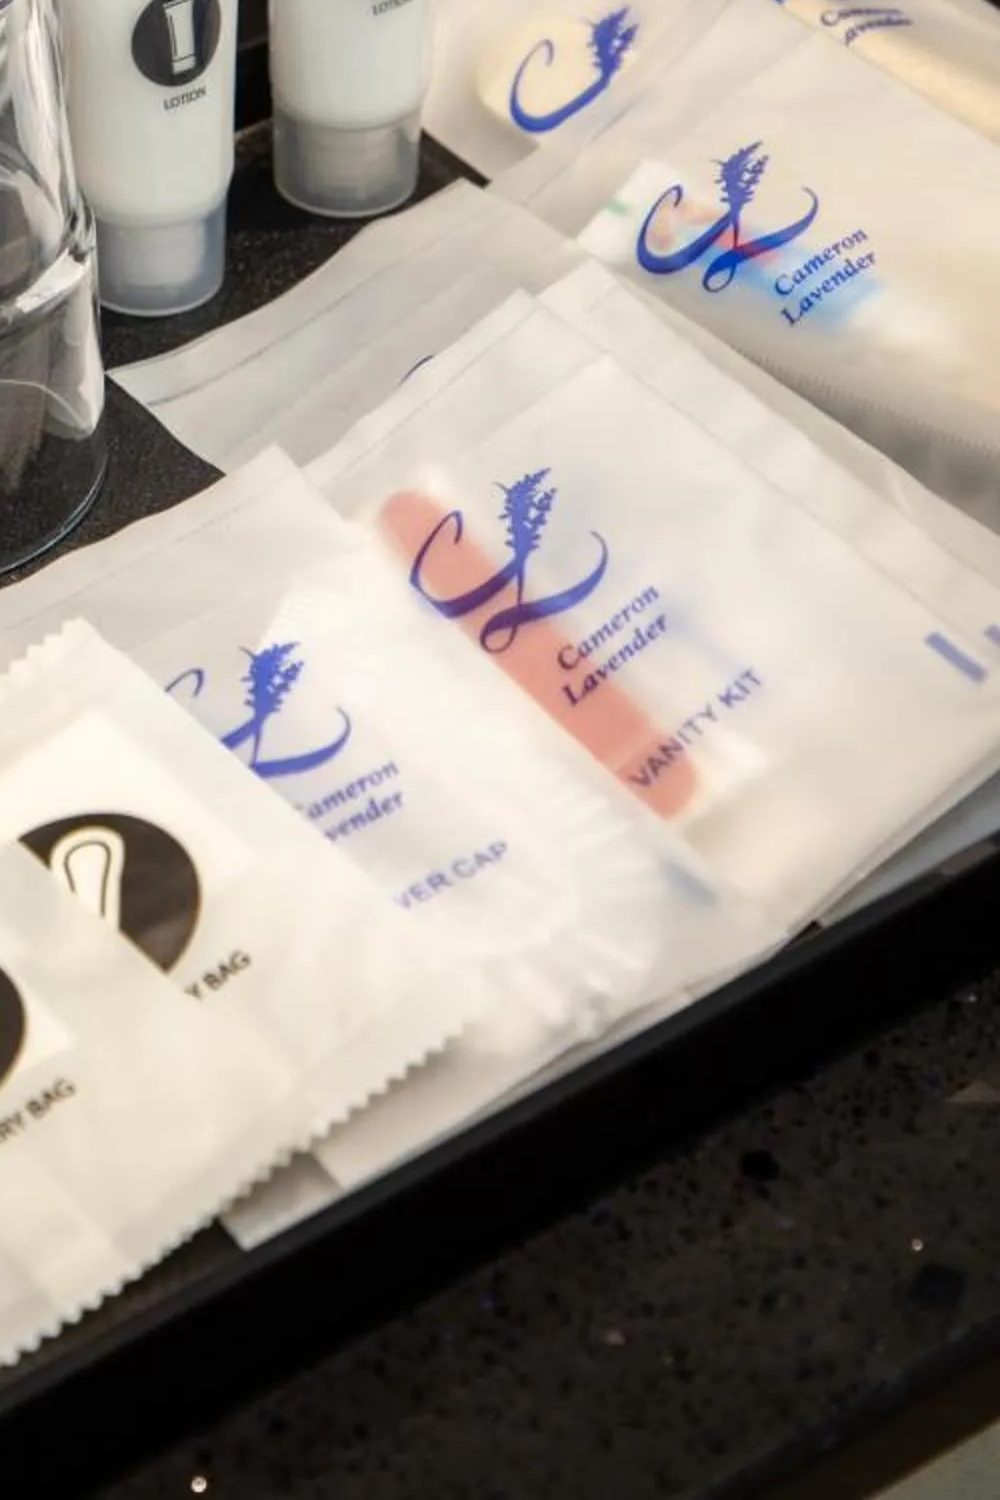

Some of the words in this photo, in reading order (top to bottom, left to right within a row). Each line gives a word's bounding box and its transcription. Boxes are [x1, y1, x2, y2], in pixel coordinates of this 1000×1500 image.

[162, 84, 207, 112] LOTION
[775, 229, 869, 296] Cameron
[781, 251, 876, 327] Lavender
[556, 585, 660, 671] Cameron
[561, 613, 667, 707] Lavender
[628, 702, 718, 787] VANITY
[717, 667, 763, 709] KIT
[297, 760, 400, 821] ameron
[324, 791, 404, 842] vender
[451, 841, 507, 879] CAP
[202, 949, 252, 991] BAG
[25, 1078, 76, 1121] BAG
